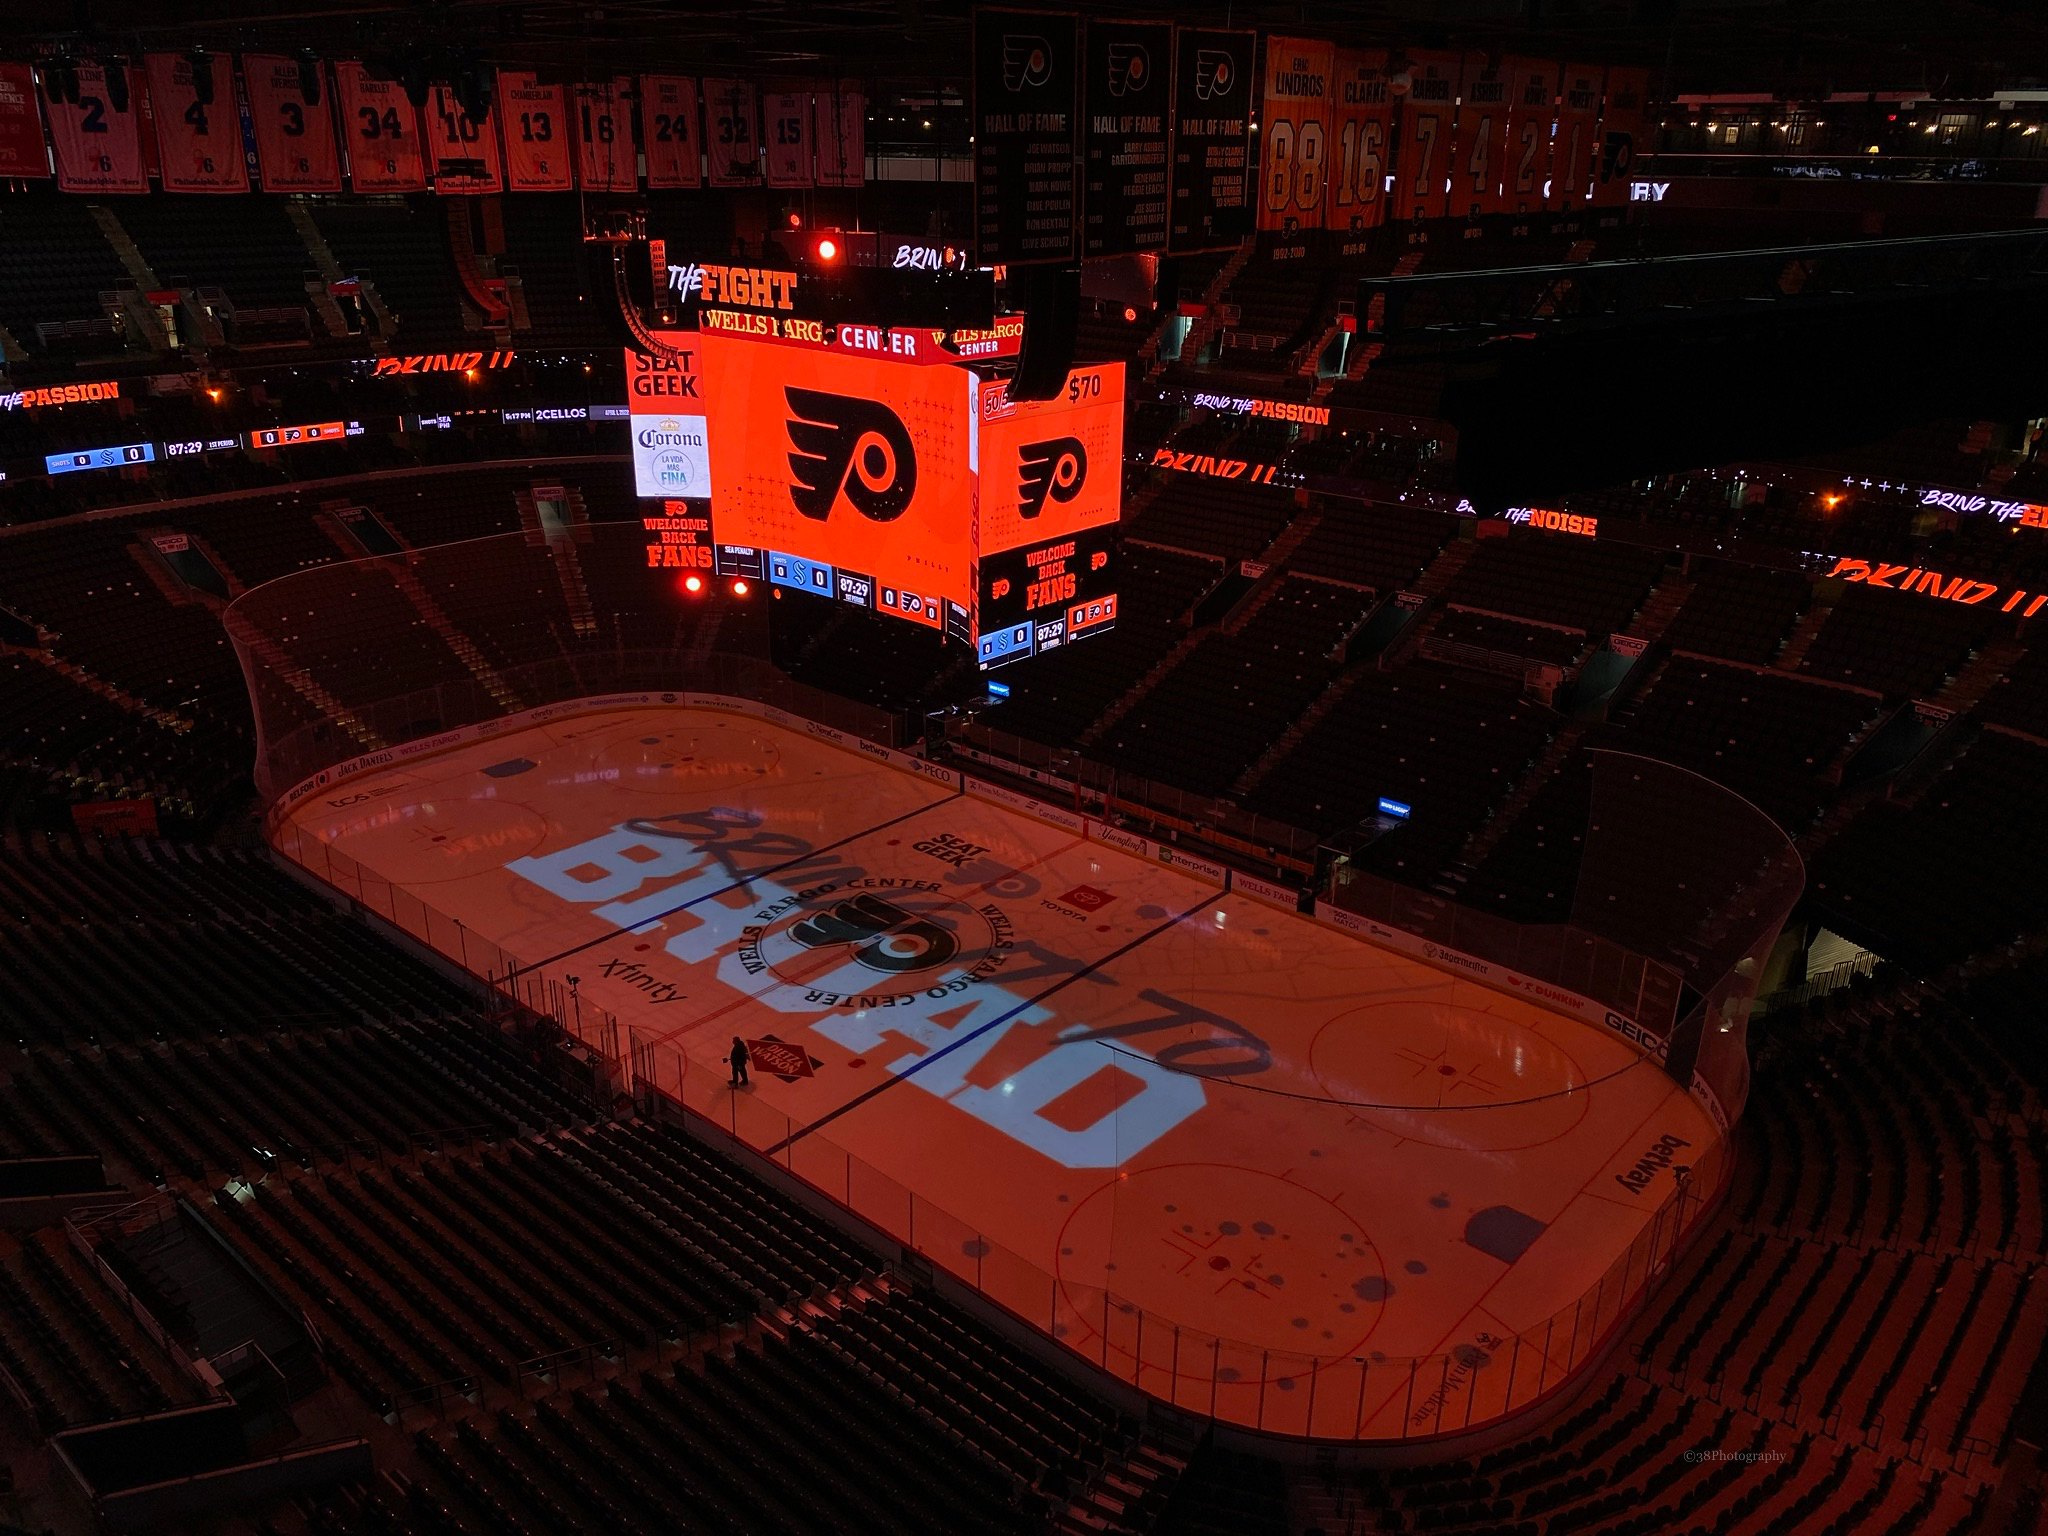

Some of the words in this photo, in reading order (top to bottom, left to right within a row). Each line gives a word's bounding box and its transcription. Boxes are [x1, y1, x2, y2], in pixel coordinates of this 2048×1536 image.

[1293, 57, 1309, 71] ERIC
[1276, 71, 1324, 97] LINDROS
[1344, 82, 1387, 104] CLARKE
[1413, 79, 1449, 100] BARBER
[78, 96, 107, 133] 2
[185, 101, 208, 135] 4
[281, 103, 304, 136] 3
[359, 107, 402, 139] 34
[985, 114, 1016, 133] HALL
[1018, 114, 1032, 132] OF
[1035, 114, 1066, 132] FAME
[1094, 115, 1118, 134] HALL
[1120, 115, 1134, 133] OF
[1135, 116, 1161, 133] FAME
[447, 112, 480, 143] 10
[520, 112, 552, 142] 13
[655, 114, 688, 142] 24
[717, 117, 749, 144] 32
[777, 118, 801, 144] 15
[1182, 119, 1206, 136] HALL
[1207, 119, 1218, 136] OF
[1220, 119, 1243, 136] FAME
[1040, 143, 1071, 154] WATSON
[1415, 113, 1439, 195] 7
[1468, 114, 1491, 194] 4
[1515, 119, 1539, 194] 2
[1563, 123, 1580, 194] 1
[89, 156, 111, 172] 76
[194, 158, 214, 173] 76
[379, 160, 397, 174] 76
[1267, 118, 1325, 213] 88
[1336, 118, 1383, 207] 16
[668, 263, 706, 303] THE
[699, 264, 798, 310] FIGHT
[707, 309, 768, 335] WELLS
[960, 341, 998, 356] CENTER
[635, 351, 695, 373] SEAT
[22, 382, 120, 408] PASSION
[634, 375, 699, 398] GEEK
[1069, 374, 1101, 403] $70
[520, 412, 531, 420] PM
[535, 408, 587, 420] 2CELLOS
[1193, 392, 1231, 411] BRING
[1232, 397, 1256, 415] THE
[1252, 399, 1331, 426] PASSION
[266, 433, 274, 443] 0
[311, 429, 317, 437] 0
[438, 422, 450, 430] PHI
[168, 442, 203, 455] 87:29
[638, 429, 702, 450] Corona
[79, 456, 86, 465] 0
[129, 448, 139, 460] 0
[661, 472, 687, 486] FINA
[1922, 489, 1987, 514] BRING
[1988, 500, 2031, 523] THE
[644, 518, 708, 531] WELCOME
[1504, 507, 1534, 525] THE
[1528, 508, 1598, 536] NOISE
[661, 532, 696, 543] BACK
[647, 545, 713, 568] FANS
[725, 546, 734, 554] SEA
[735, 547, 754, 556] PENALTY
[1026, 542, 1075, 567] WELCOME
[778, 567, 784, 576] 0
[816, 571, 824, 586] 0
[1039, 560, 1065, 580] BACK
[840, 578, 868, 596] 87:29
[885, 590, 893, 605] 0
[1027, 573, 1076, 611] FANS
[928, 607, 935, 618] 0
[1077, 611, 1083, 623] 0
[1106, 605, 1111, 613] 0
[985, 645, 990, 653] 0
[1018, 630, 1024, 642] 0
[1037, 622, 1063, 641] 87:29
[1614, 639, 1643, 649] GEICO
[400, 739, 431, 756] WELLS
[432, 733, 461, 751] FARGO
[860, 739, 890, 760] betway
[338, 762, 358, 778] JACK
[924, 763, 951, 783] PECO
[289, 781, 315, 802] BELFOR
[1038, 807, 1078, 830] Constellation
[932, 833, 991, 857] SEAT
[1100, 826, 1142, 853] Yuengling
[912, 841, 974, 868] GEEK
[1239, 877, 1271, 898] WELLS
[1040, 899, 1088, 923] TOYOTA
[739, 925, 765, 976] WELLS
[754, 883, 837, 922] FARGO
[846, 877, 943, 893] CENTER
[979, 903, 1014, 950] WELLS
[598, 958, 688, 1004] xfinity
[928, 951, 1007, 1000] FARGO
[505, 822, 1208, 1169] BROAD
[804, 989, 917, 1009] CENTER
[1048, 987, 1273, 1077] TO
[1604, 1012, 1670, 1060] GEICO
[751, 1046, 804, 1074] WATSON
[766, 1044, 801, 1061] DIETZ
[1615, 1134, 1692, 1195] betway
